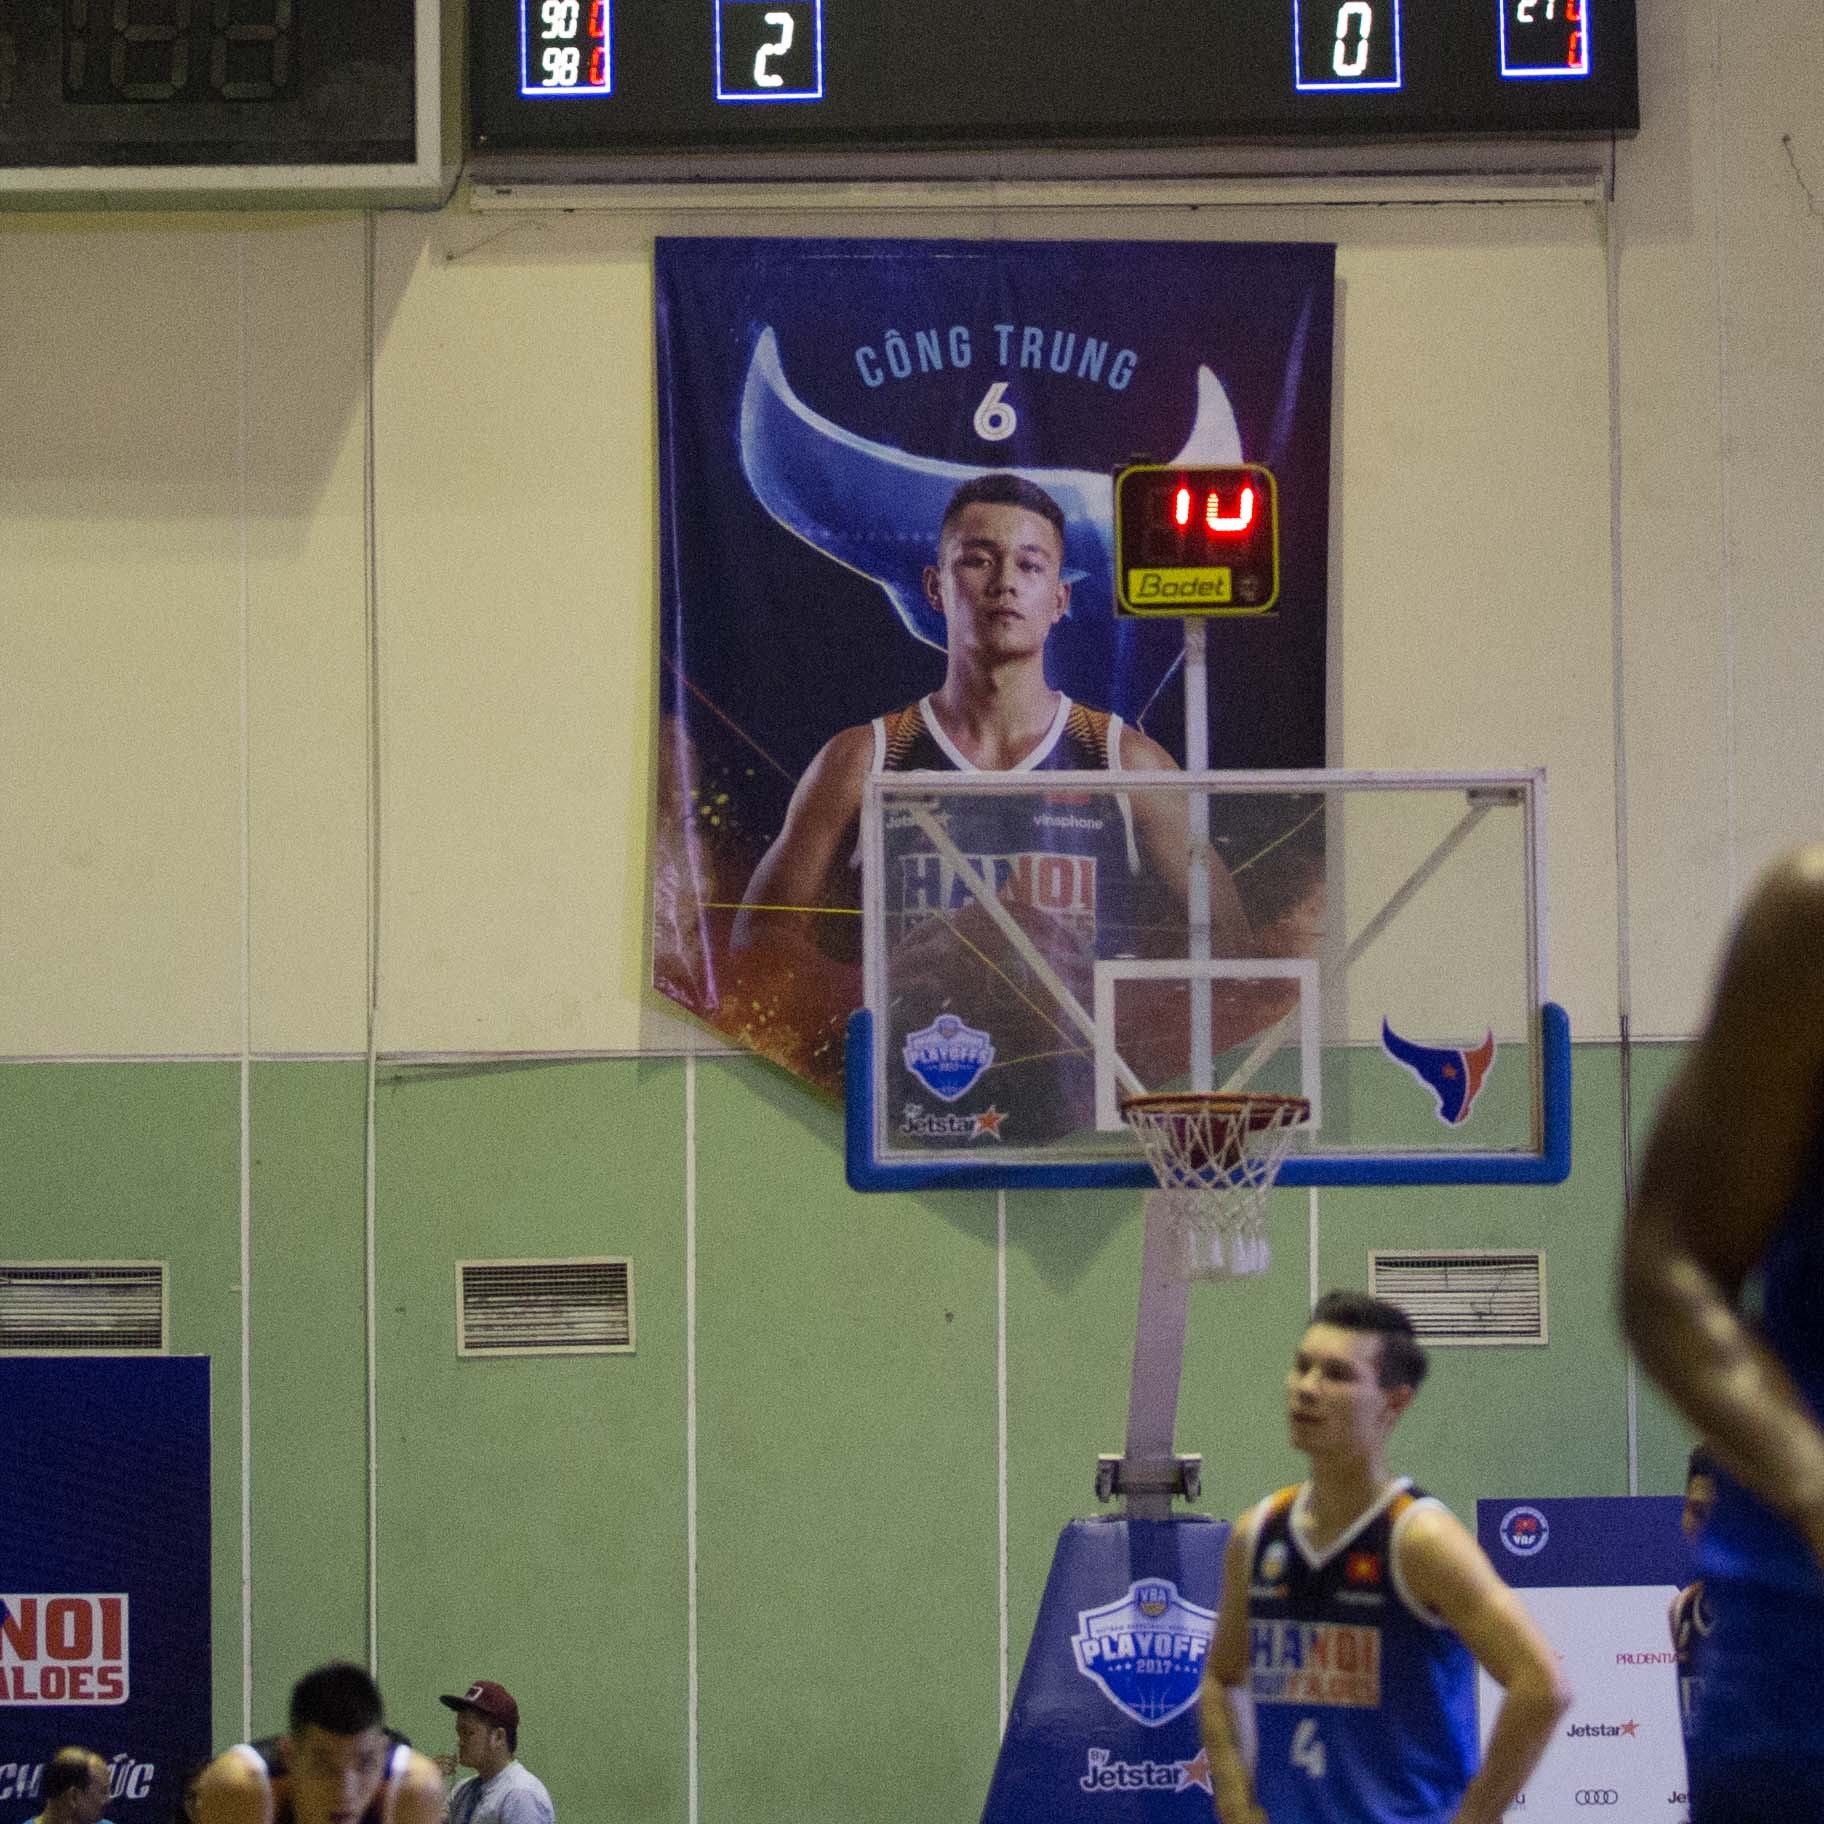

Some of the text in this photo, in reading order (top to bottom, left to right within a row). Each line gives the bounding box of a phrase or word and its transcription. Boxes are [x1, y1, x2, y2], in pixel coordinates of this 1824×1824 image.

[753, 11, 795, 88] 2
[1332, 1, 1373, 77] 0
[541, 46, 581, 87] 98
[855, 324, 1138, 390] CÔNG TRUNG
[973, 381, 1017, 442] 6
[1080, 1632, 1209, 1667] PLAYOFF
[1616, 1652, 1677, 1666] PRUDENTIA
[1288, 1717, 1327, 1779] 4
[1566, 1723, 1620, 1739] Jetstar
[1083, 1762, 1185, 1789] Jetstar
